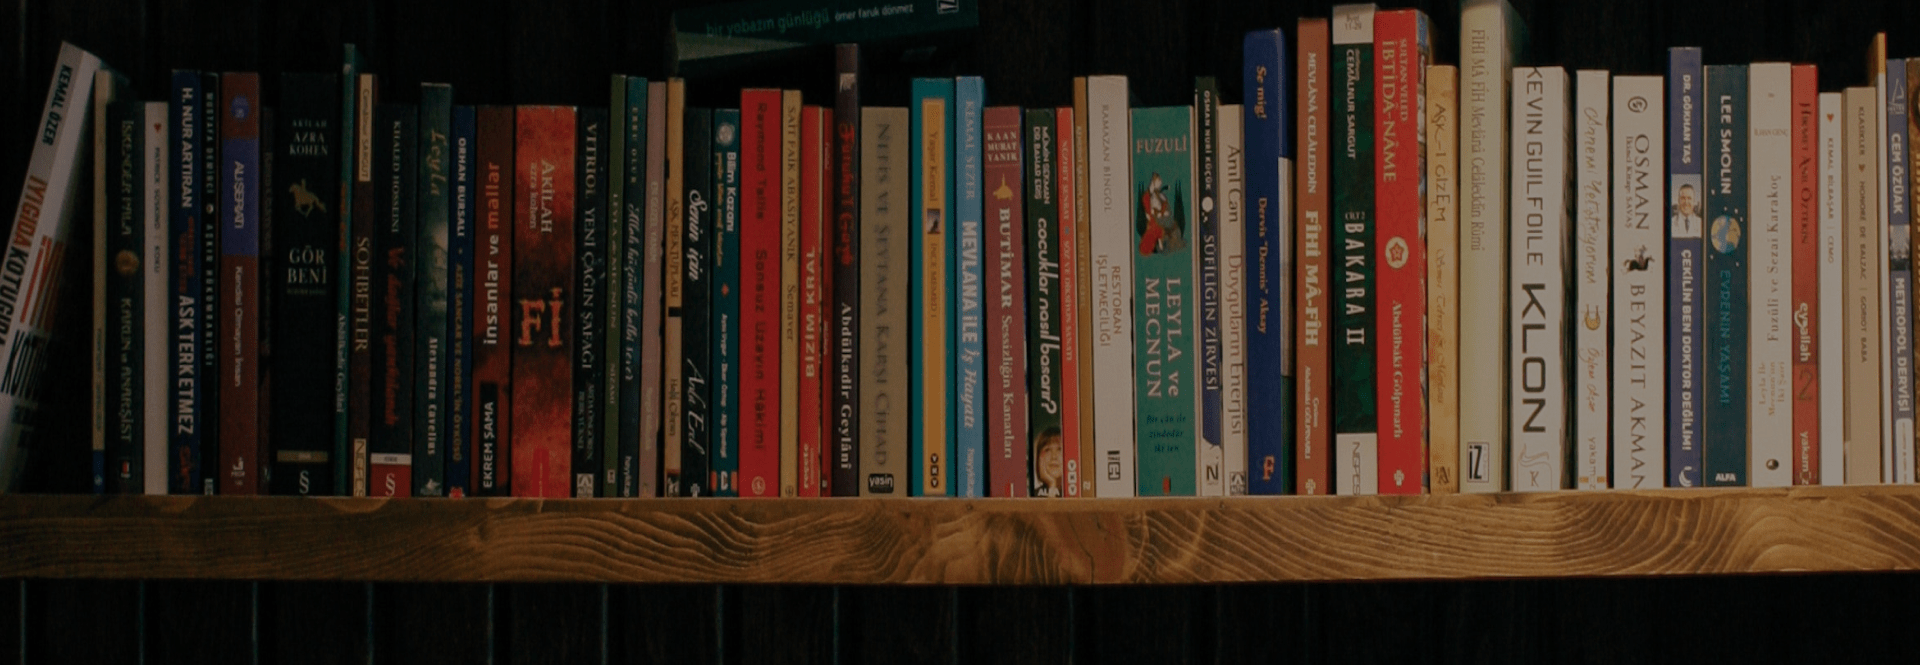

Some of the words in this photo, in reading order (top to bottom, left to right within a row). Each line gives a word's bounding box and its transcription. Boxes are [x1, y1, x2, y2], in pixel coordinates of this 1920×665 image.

[858, 7, 879, 18] faruk
[1257, 66, 1266, 85] Se
[1400, 39, 1408, 82] SULTAN
[1682, 74, 1691, 92] DR.
[51, 65, 74, 109] KEMAL
[183, 88, 193, 102] H.
[1254, 87, 1266, 118] mig!
[1382, 41, 1398, 182] İBTİDÂ-NÂME
[1400, 85, 1408, 121] VELED
[1527, 66, 1542, 134] KEVIN
[1721, 95, 1731, 123] LEE
[42, 112, 62, 147] ÖZER
[182, 106, 192, 138] NUR
[206, 93, 214, 141] MUSTAFA
[294, 132, 324, 142] AZRA
[756, 102, 768, 172] Raymond
[987, 131, 1016, 142] KAAN
[1102, 104, 1111, 161] RAMAZAN
[1204, 128, 1213, 153] NURİ
[1347, 115, 1356, 159] SARGUT
[1683, 96, 1692, 140] GÖKHAN
[290, 145, 328, 155] KOHEN
[391, 120, 401, 171] KHALED
[427, 129, 448, 197] Leyla
[457, 138, 467, 181] ORHAN
[727, 152, 737, 183] Bilim
[987, 142, 1017, 151] MURAT
[987, 152, 1017, 161] YANIK
[1228, 144, 1243, 183] Anıl
[1681, 143, 1691, 164] TAŞ
[1721, 129, 1731, 193] SMOLIN
[1892, 133, 1901, 162] CEM
[182, 141, 192, 207] ARTIRAN
[486, 163, 499, 229] mallar
[530, 163, 539, 190] azra
[540, 159, 556, 234] AKİLAH
[929, 165, 938, 201] Kemal
[1635, 134, 1649, 229] OSMAN
[1892, 165, 1904, 213] ÖZÜAK
[122, 197, 134, 235] PALA
[390, 175, 400, 233] HOSSEINI
[456, 185, 466, 237] BURSALI
[530, 192, 541, 229] kohen
[585, 208, 595, 246] YENİ
[669, 198, 680, 222] AŞK
[689, 190, 707, 241] Senin
[727, 187, 736, 231] Kazanı
[786, 177, 797, 262] ABASIYANIK
[878, 192, 888, 213] VE
[1229, 187, 1241, 223] Can
[1527, 142, 1543, 265] GUILFOILE
[289, 246, 324, 264] GÖR
[489, 235, 499, 256] ve
[1000, 208, 1013, 307] BUTİMAR
[1767, 239, 1778, 273] Sezai
[1860, 226, 1866, 239] DE
[288, 268, 326, 283] BENİ
[582, 251, 596, 306] ÇAĞIN
[687, 248, 703, 280] için
[755, 249, 767, 312] Sonsuz
[805, 247, 814, 304] KRAL
[962, 221, 977, 311] MEVLANA
[1345, 223, 1365, 315] BAKARA
[1682, 250, 1693, 302] ÇEKİLİN
[1770, 279, 1778, 292] ve
[355, 238, 369, 351] SOHBETLER
[485, 261, 498, 344] insanlar
[787, 284, 798, 341] Semaver
[1040, 298, 1059, 341] nasıl
[1098, 255, 1110, 346] İŞLETMECİLİĞİ
[1112, 266, 1122, 334] RESTORAN
[1167, 279, 1181, 361] LEYLA
[1226, 253, 1243, 357] Duyguların
[1258, 299, 1269, 333] Aksay
[1682, 305, 1691, 333] BEN
[1896, 278, 1906, 353] METROPOL
[122, 298, 131, 350] KARUN
[581, 312, 595, 368] ŞAFAĞI
[805, 314, 815, 377] BİZİM
[1146, 278, 1161, 397] MECNUN
[1347, 328, 1364, 345] II
[1631, 285, 1645, 388] BEYAZIT
[429, 338, 438, 399] Alexandra
[841, 303, 851, 398] Abdülkadir
[875, 326, 888, 383] KARŞI
[1000, 316, 1012, 387] Sessizliğin
[1206, 327, 1218, 390] ZİRVESİ
[1522, 284, 1545, 432] KLON
[1682, 336, 1691, 389] DOKTOR
[961, 368, 976, 429] Hayatı
[1168, 372, 1179, 397] ve
[1230, 362, 1246, 436] Enerjisi
[1392, 371, 1403, 438] Gölpınarlı
[1898, 357, 1910, 411] DERVİŞİ
[428, 404, 437, 456] Cavelius
[484, 402, 494, 439] ŞAMA
[839, 405, 851, 469] Geylânî
[1003, 393, 1015, 458] Kanatları
[1630, 398, 1645, 491] AKMAN
[1682, 392, 1693, 450] DEĞİLİM!
[483, 443, 493, 488] EKREM
[1715, 473, 1736, 481] ALFA
